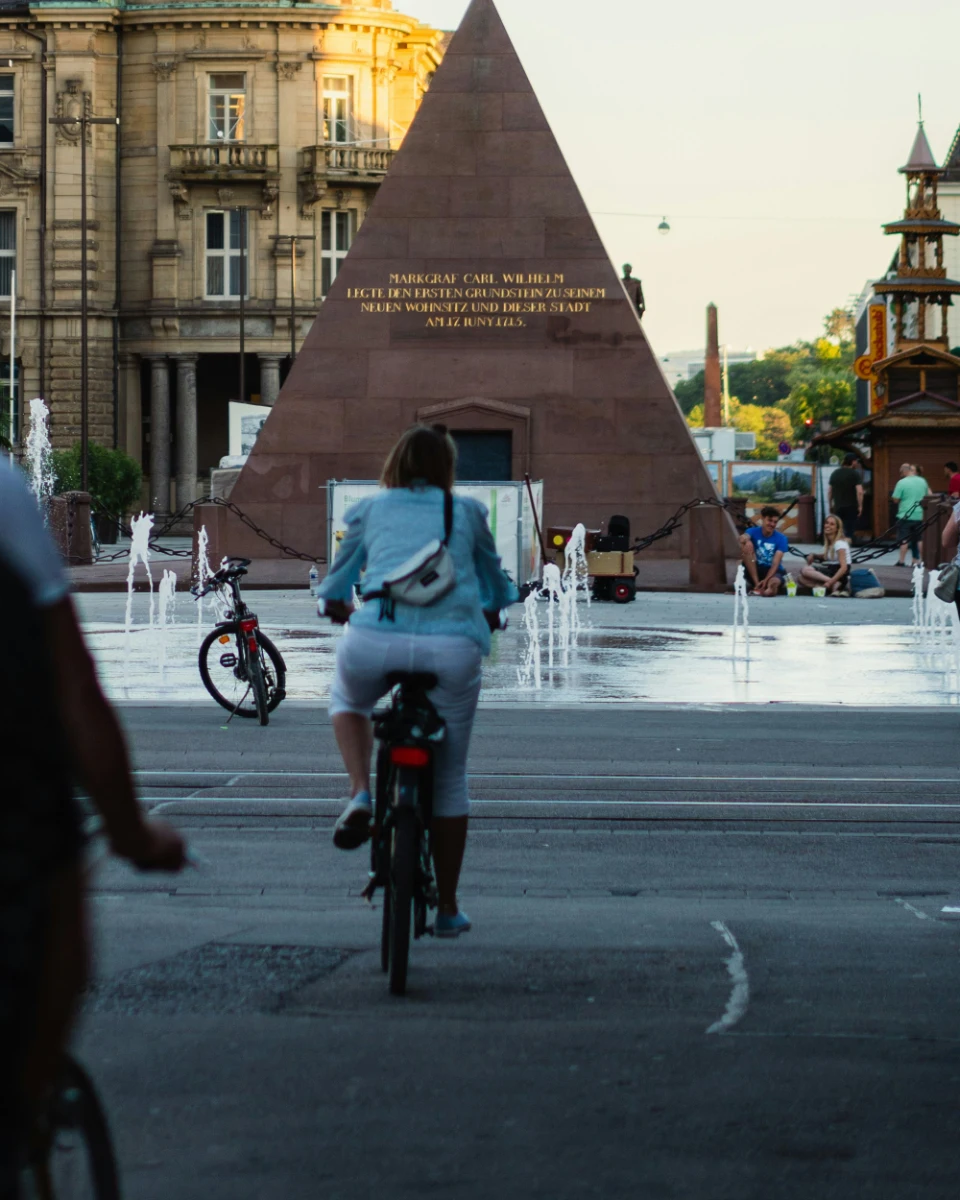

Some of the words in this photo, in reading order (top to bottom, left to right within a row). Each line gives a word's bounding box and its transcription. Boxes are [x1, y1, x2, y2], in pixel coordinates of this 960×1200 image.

[389, 273, 459, 284] MARKGRAF
[463, 273, 498, 284] CARL
[502, 273, 564, 284] WILHELM
[346, 287, 385, 298] LEGTE
[388, 287, 412, 298] DEN
[414, 287, 463, 298] ERSTEN
[465, 287, 543, 298] GRUNDSTEIN
[545, 287, 561, 298] ZU
[562, 287, 606, 298] SEINEM
[360, 302, 401, 313] NEUEN
[405, 302, 468, 313] WOHNSITZ
[471, 302, 499, 313] UND
[503, 302, 546, 313] DIESER
[549, 302, 591, 313] STADT
[425, 316, 444, 327] AM
